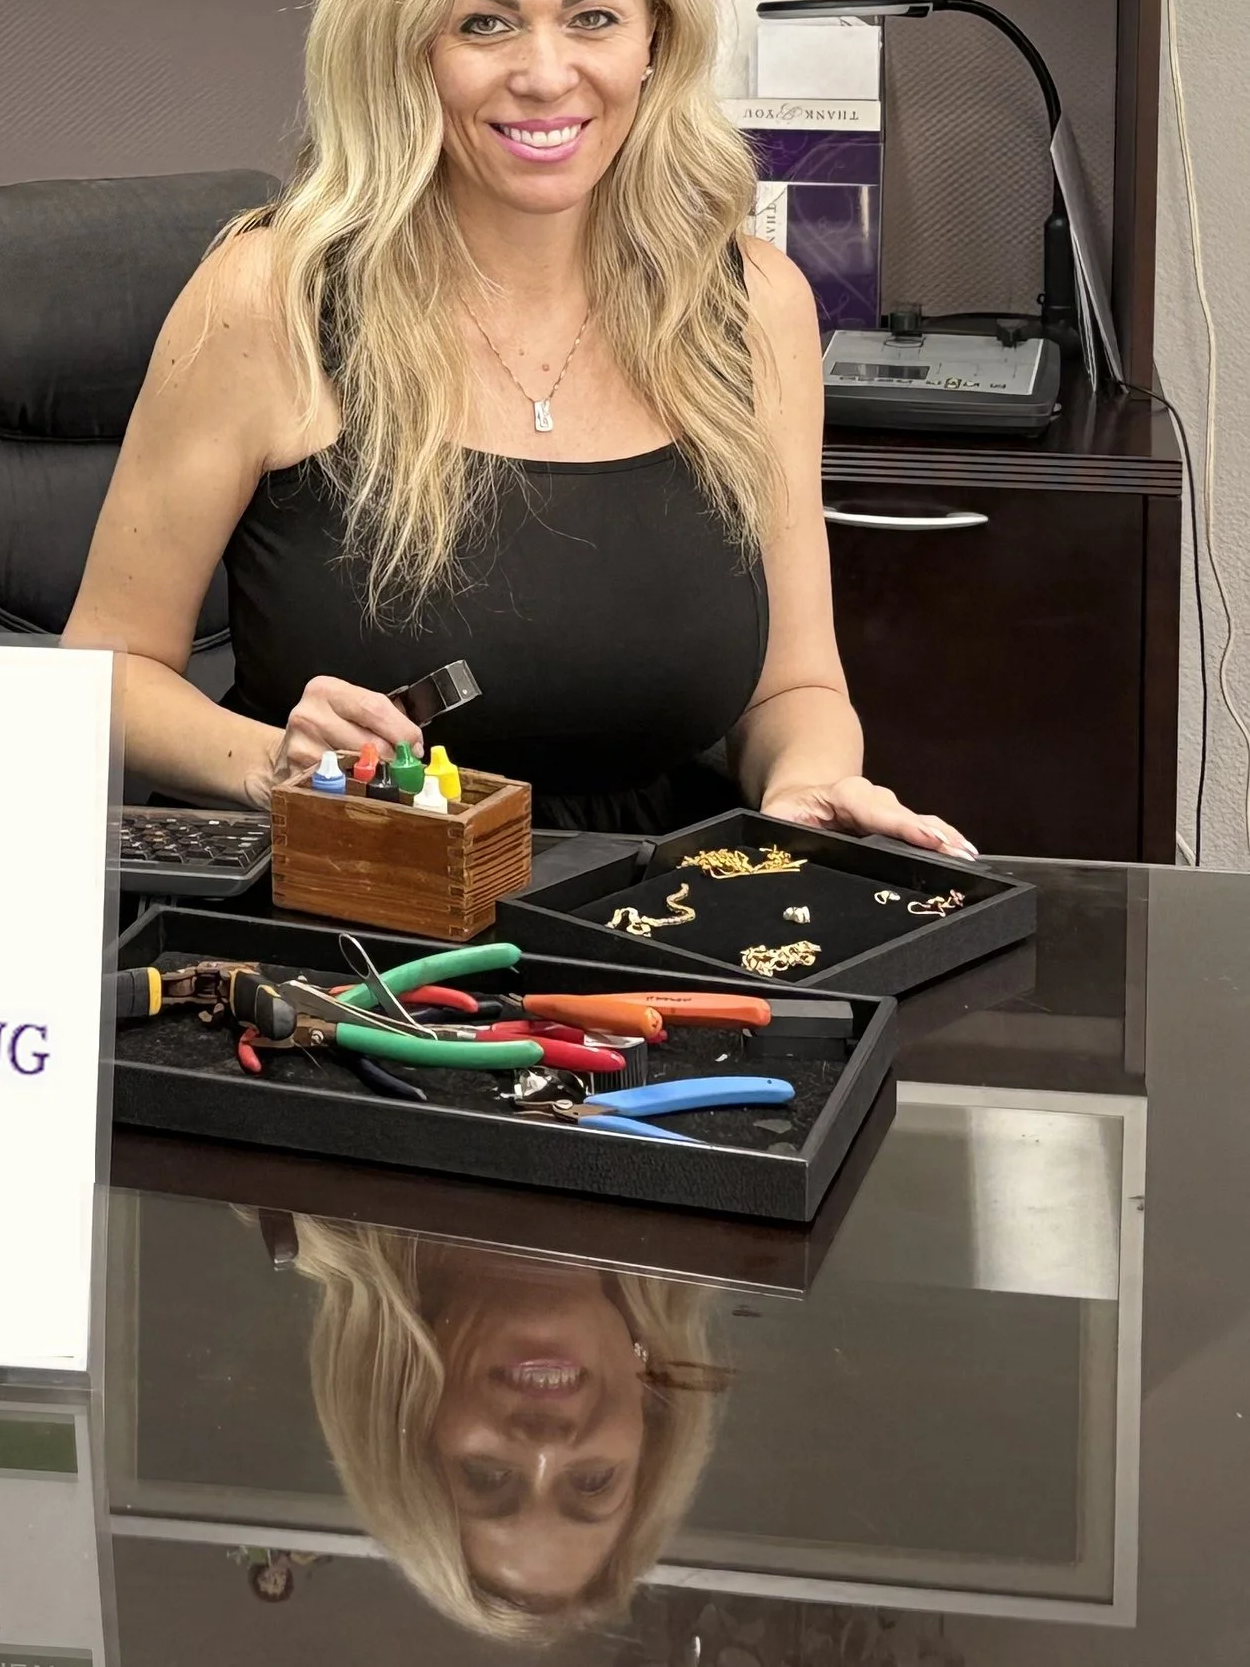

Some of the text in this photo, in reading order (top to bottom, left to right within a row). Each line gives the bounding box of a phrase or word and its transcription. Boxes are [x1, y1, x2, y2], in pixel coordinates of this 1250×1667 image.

[742, 109, 859, 121] THANK YOU
[766, 203, 777, 244] THAN
